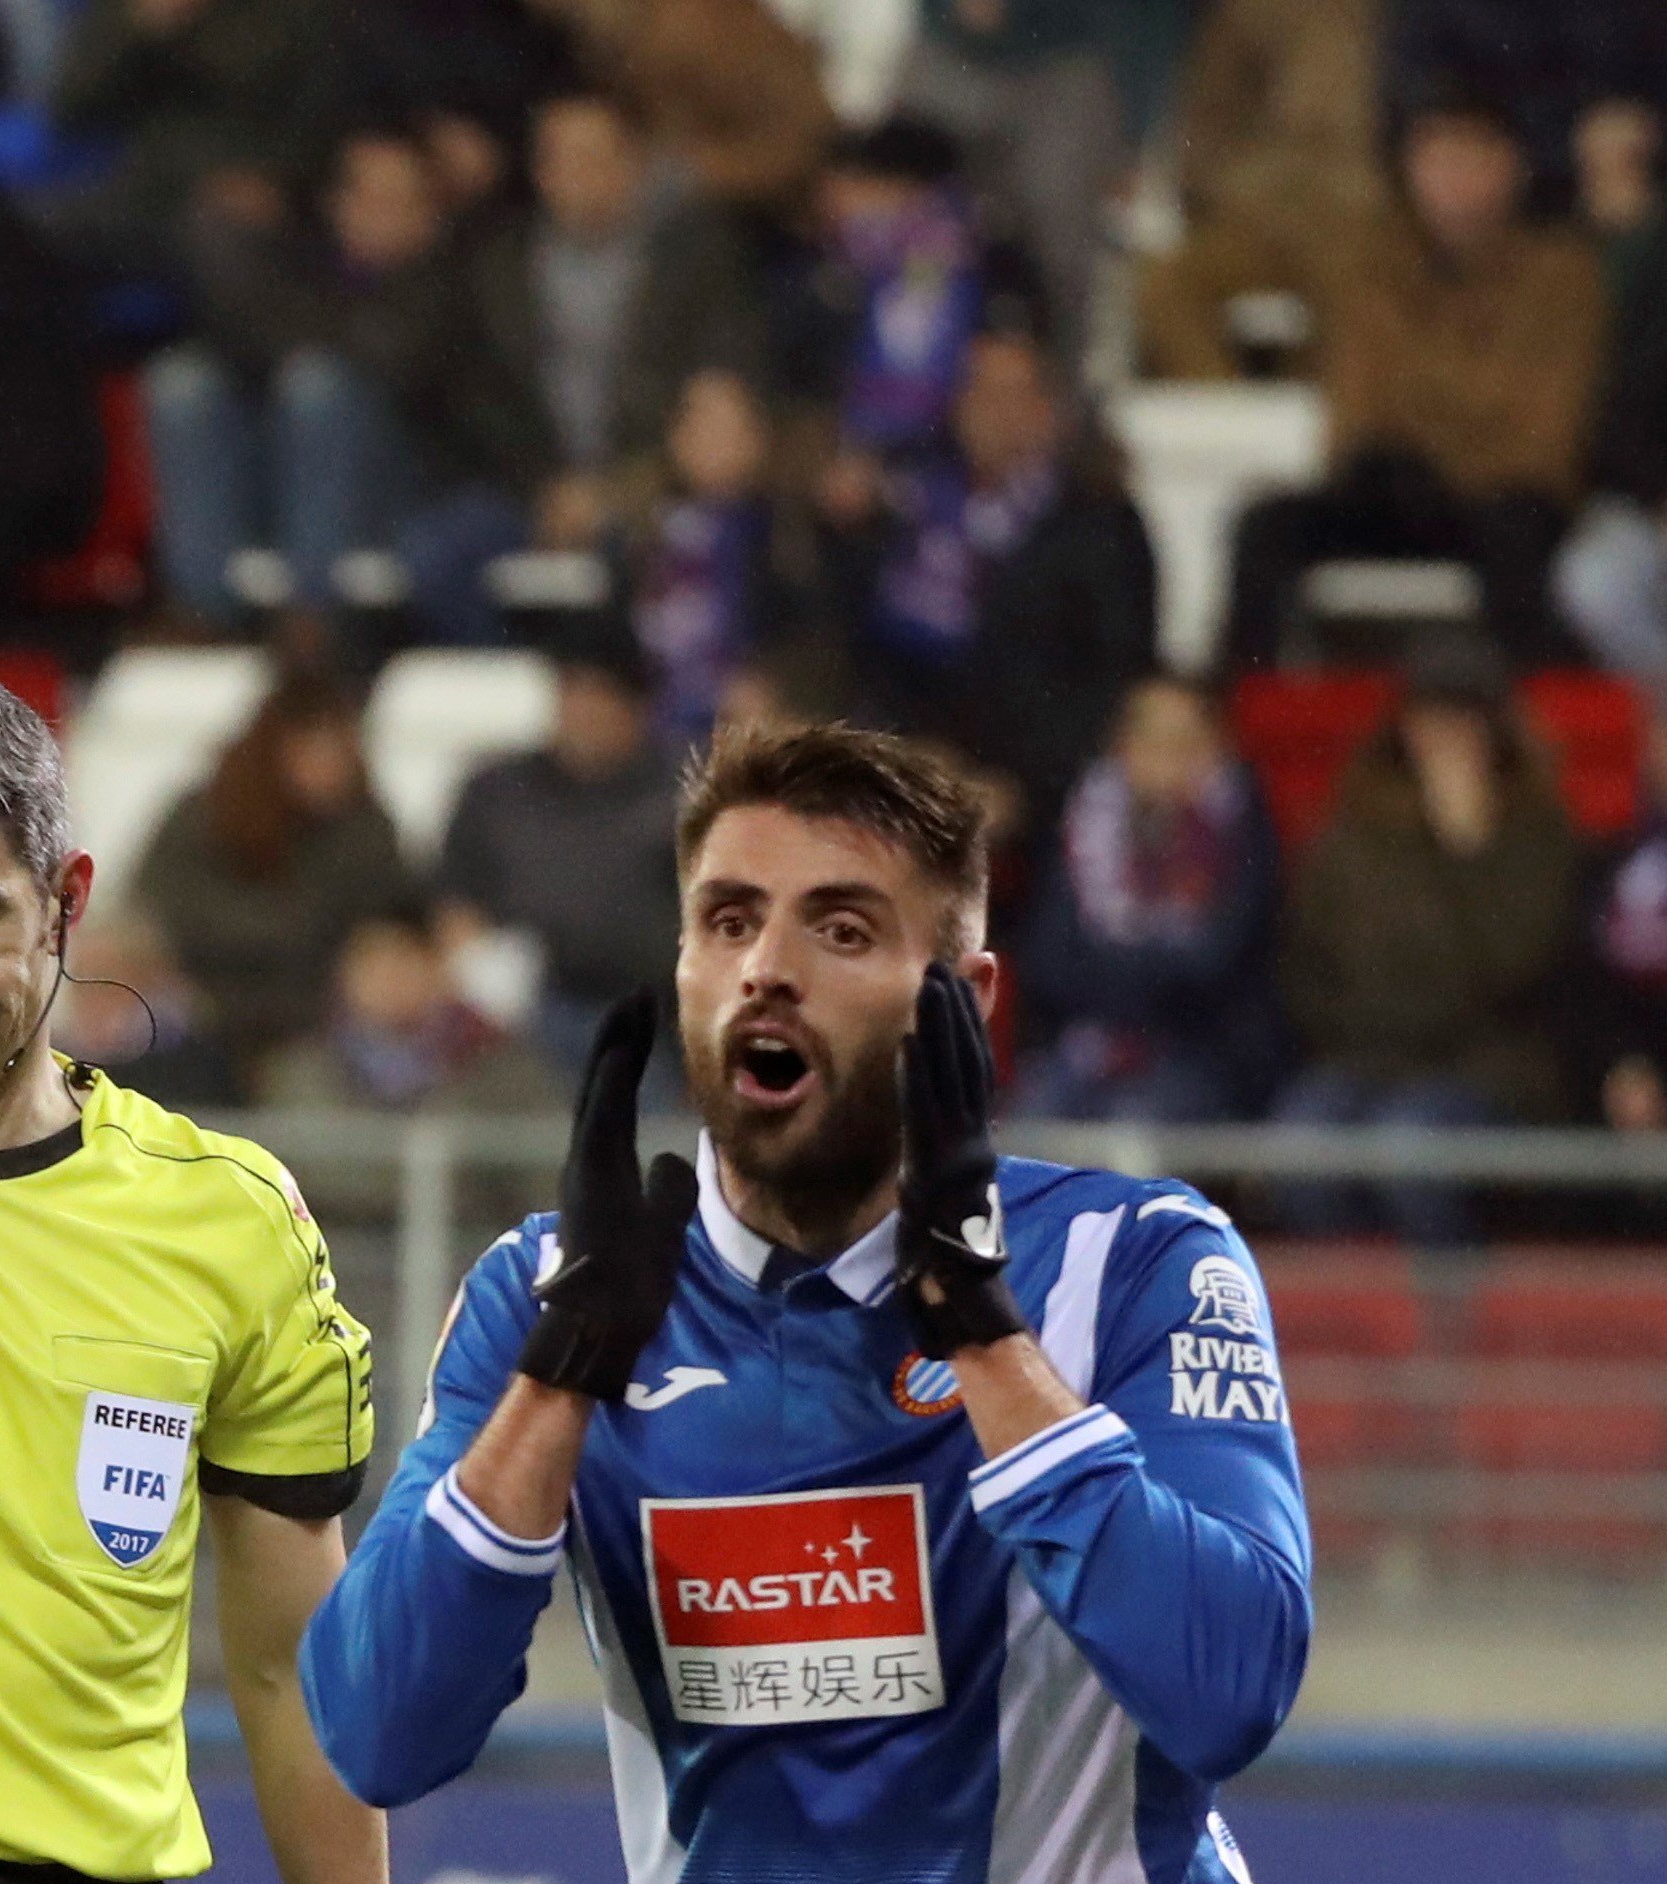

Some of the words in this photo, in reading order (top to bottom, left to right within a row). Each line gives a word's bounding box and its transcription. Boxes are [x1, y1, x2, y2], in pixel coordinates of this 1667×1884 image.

[1168, 1331, 1268, 1374] RIVIE
[1169, 1370, 1281, 1421] MAY
[94, 1404, 187, 1440] REFEREE
[103, 1464, 167, 1502] FIFA
[108, 1531, 150, 1554] 2017
[676, 1567, 896, 1613] RASTAR
[679, 1651, 931, 1712] 星辉娱乐
